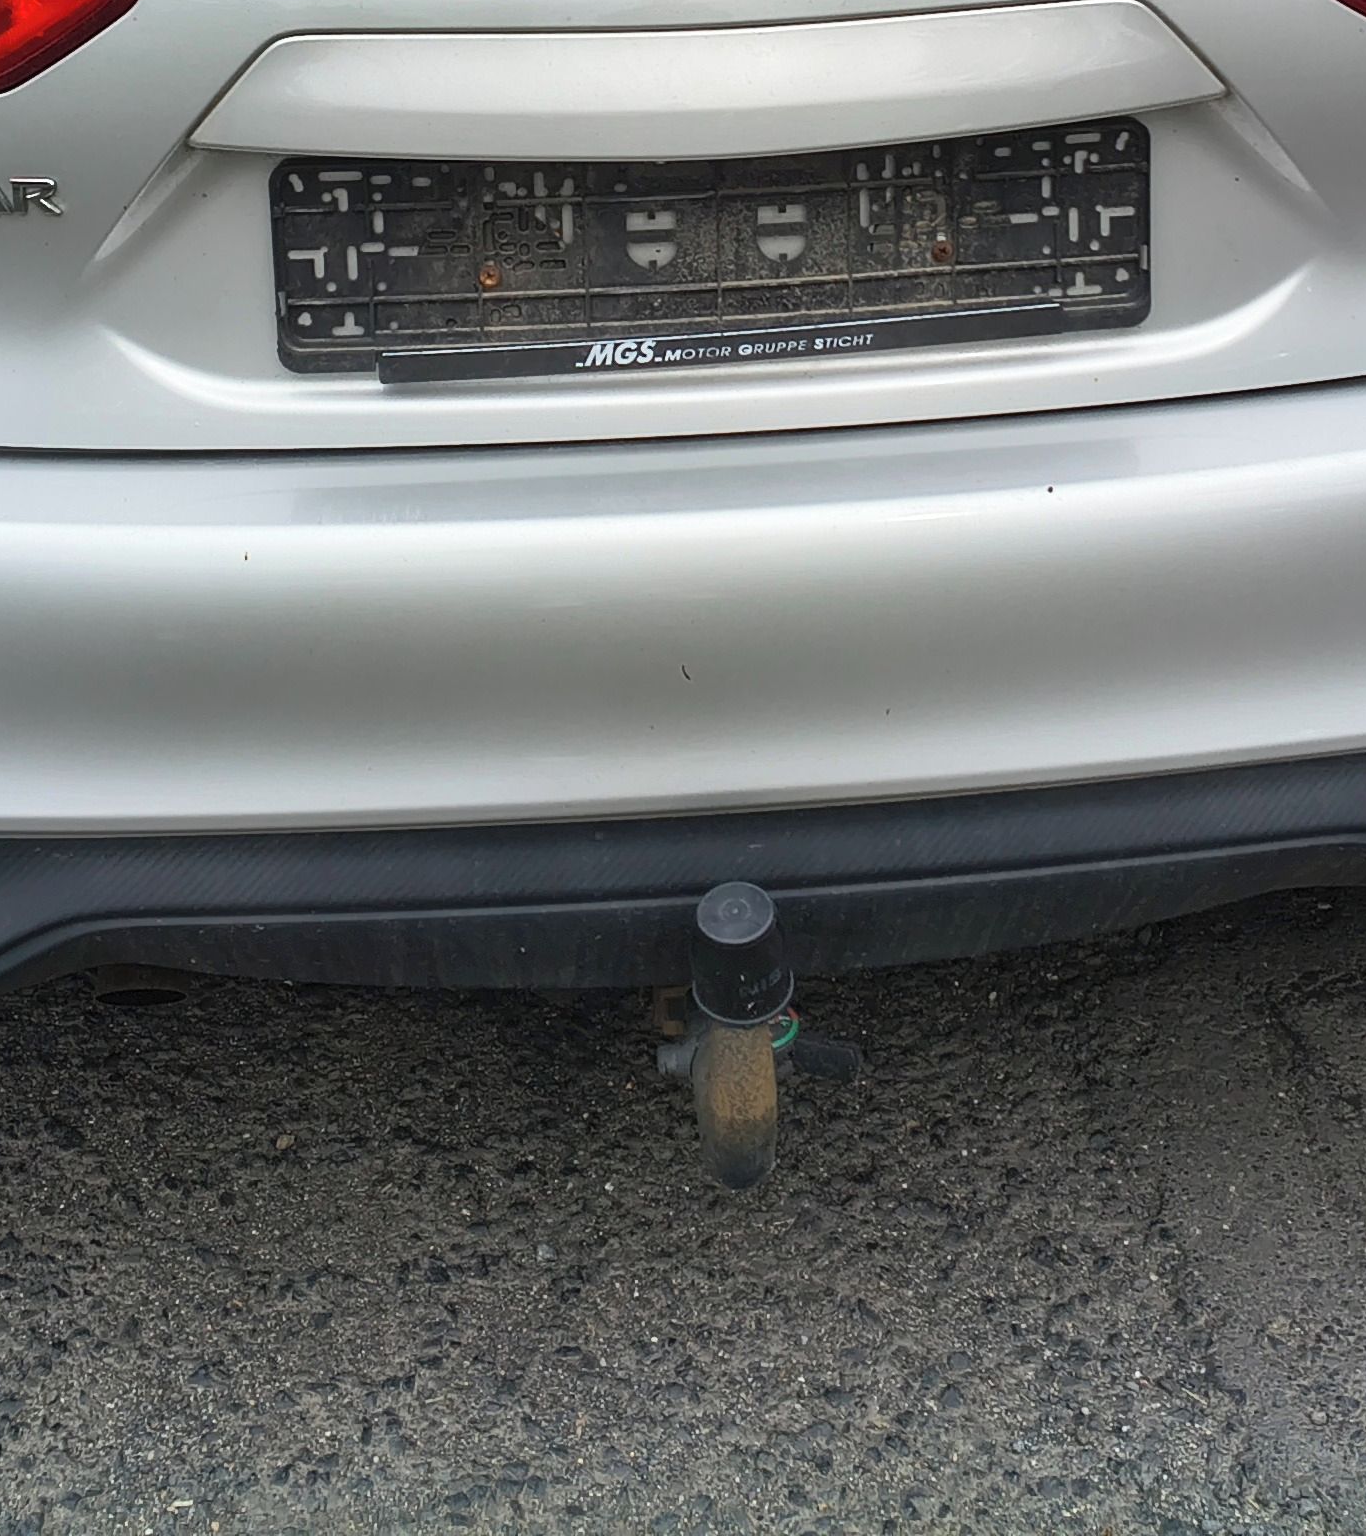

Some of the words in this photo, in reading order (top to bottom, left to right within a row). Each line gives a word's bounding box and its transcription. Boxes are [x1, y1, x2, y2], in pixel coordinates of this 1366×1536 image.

[664, 346, 732, 362] MOTOR
[738, 340, 807, 356] GRUPPE
[813, 334, 874, 351] STICHT
